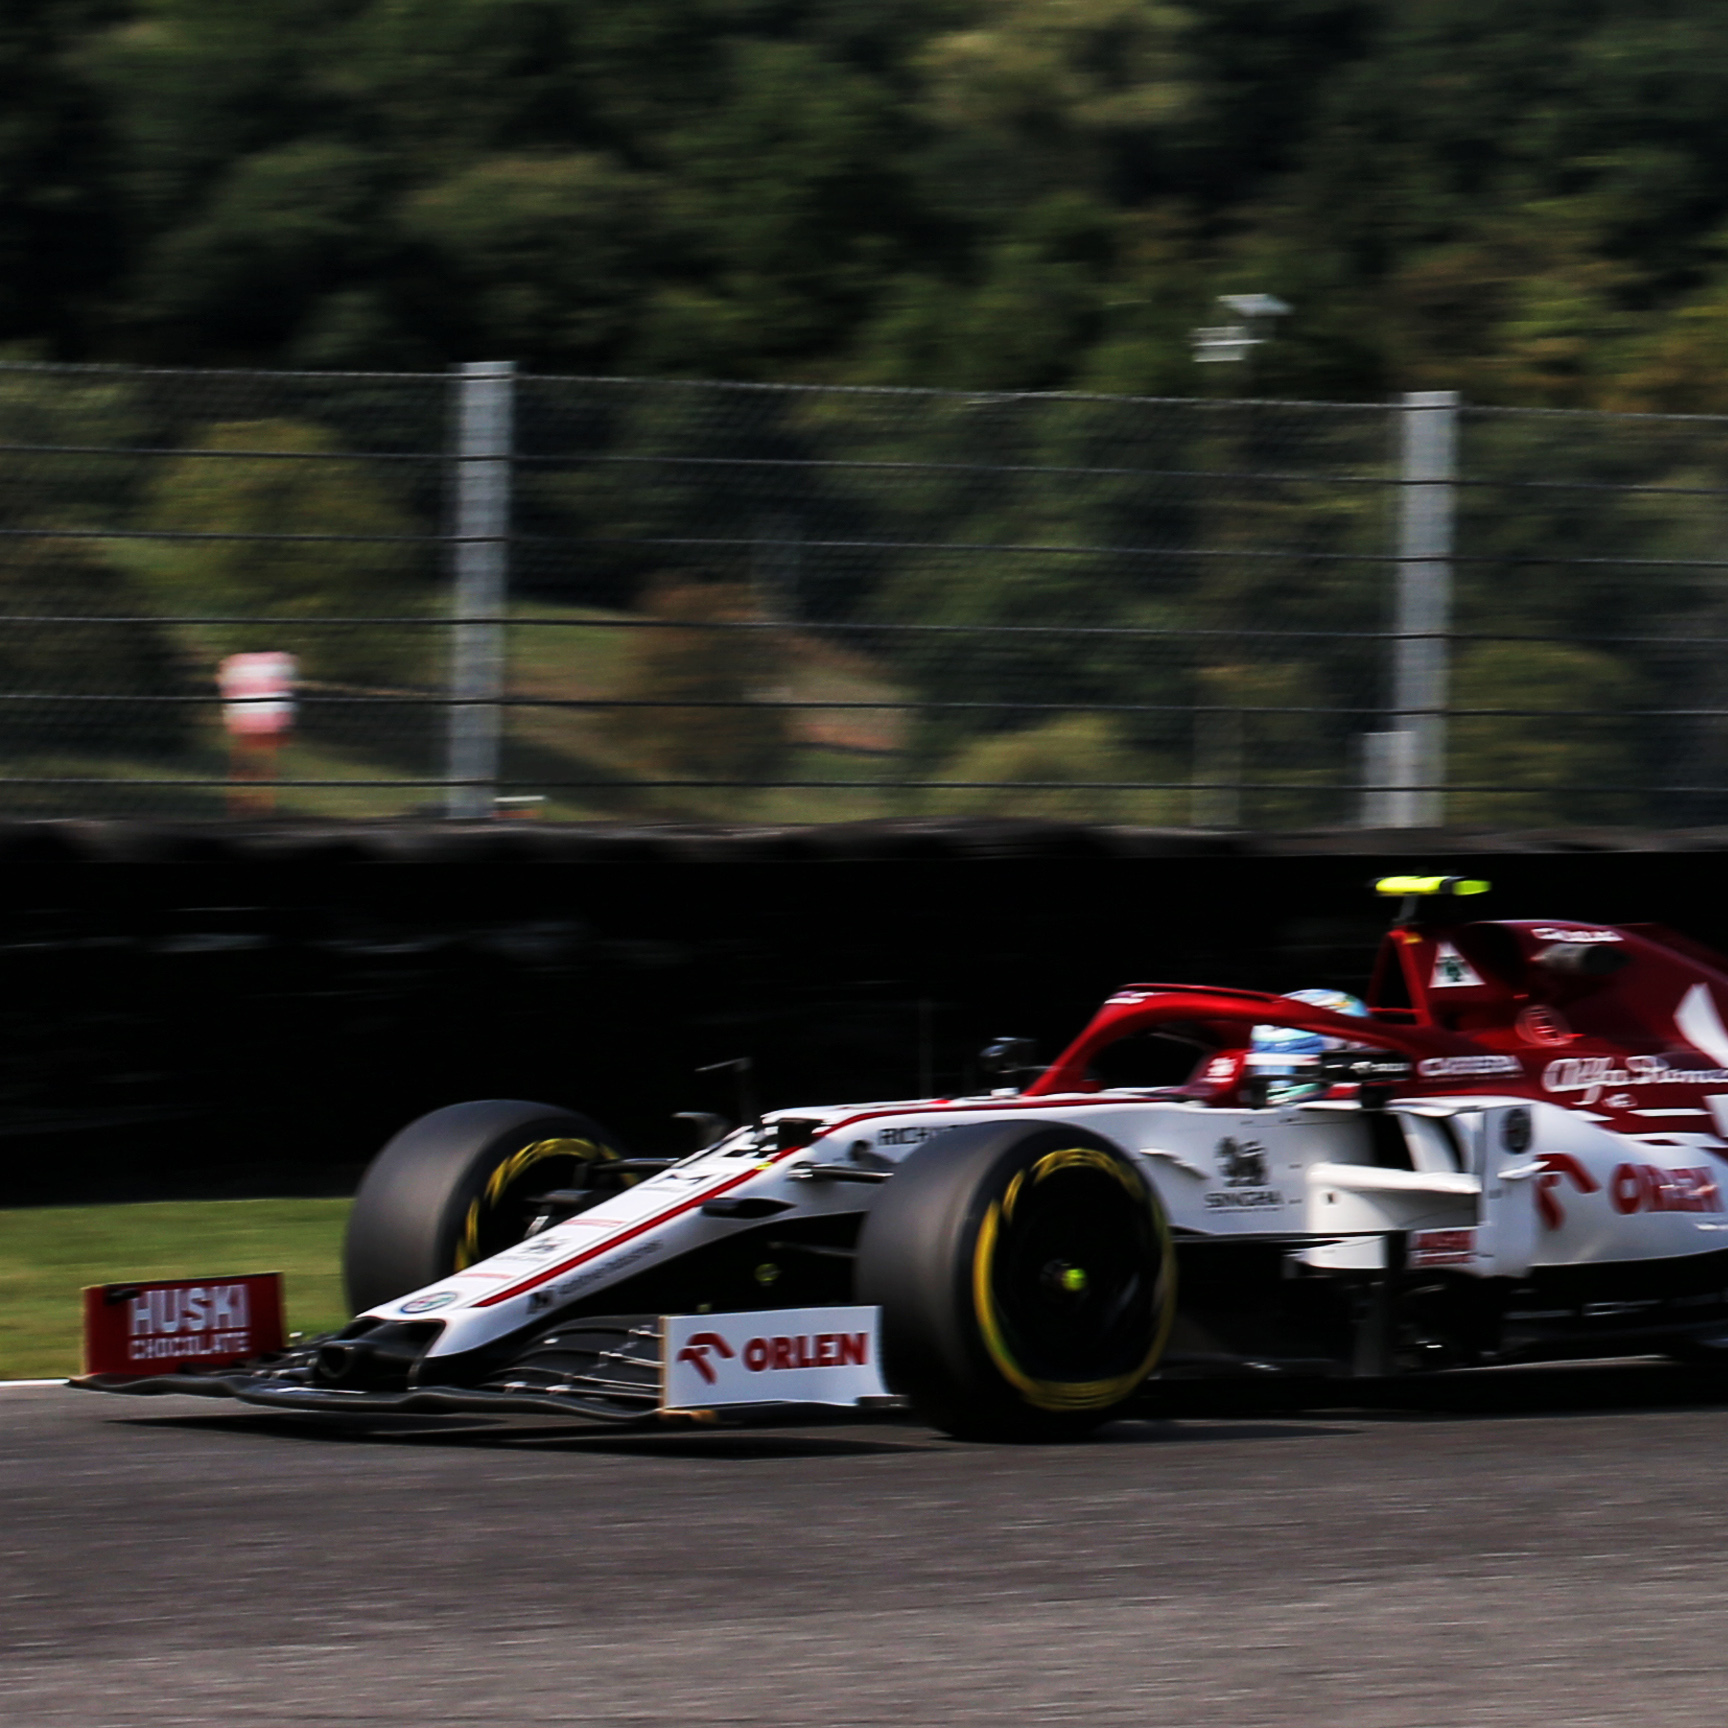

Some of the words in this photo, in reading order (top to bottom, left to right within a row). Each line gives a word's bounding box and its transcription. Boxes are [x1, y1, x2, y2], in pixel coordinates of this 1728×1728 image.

[1541, 1056, 1629, 1105] Alfa
[131, 1283, 248, 1337] HUSKI
[743, 1331, 869, 1374] ORLEN
